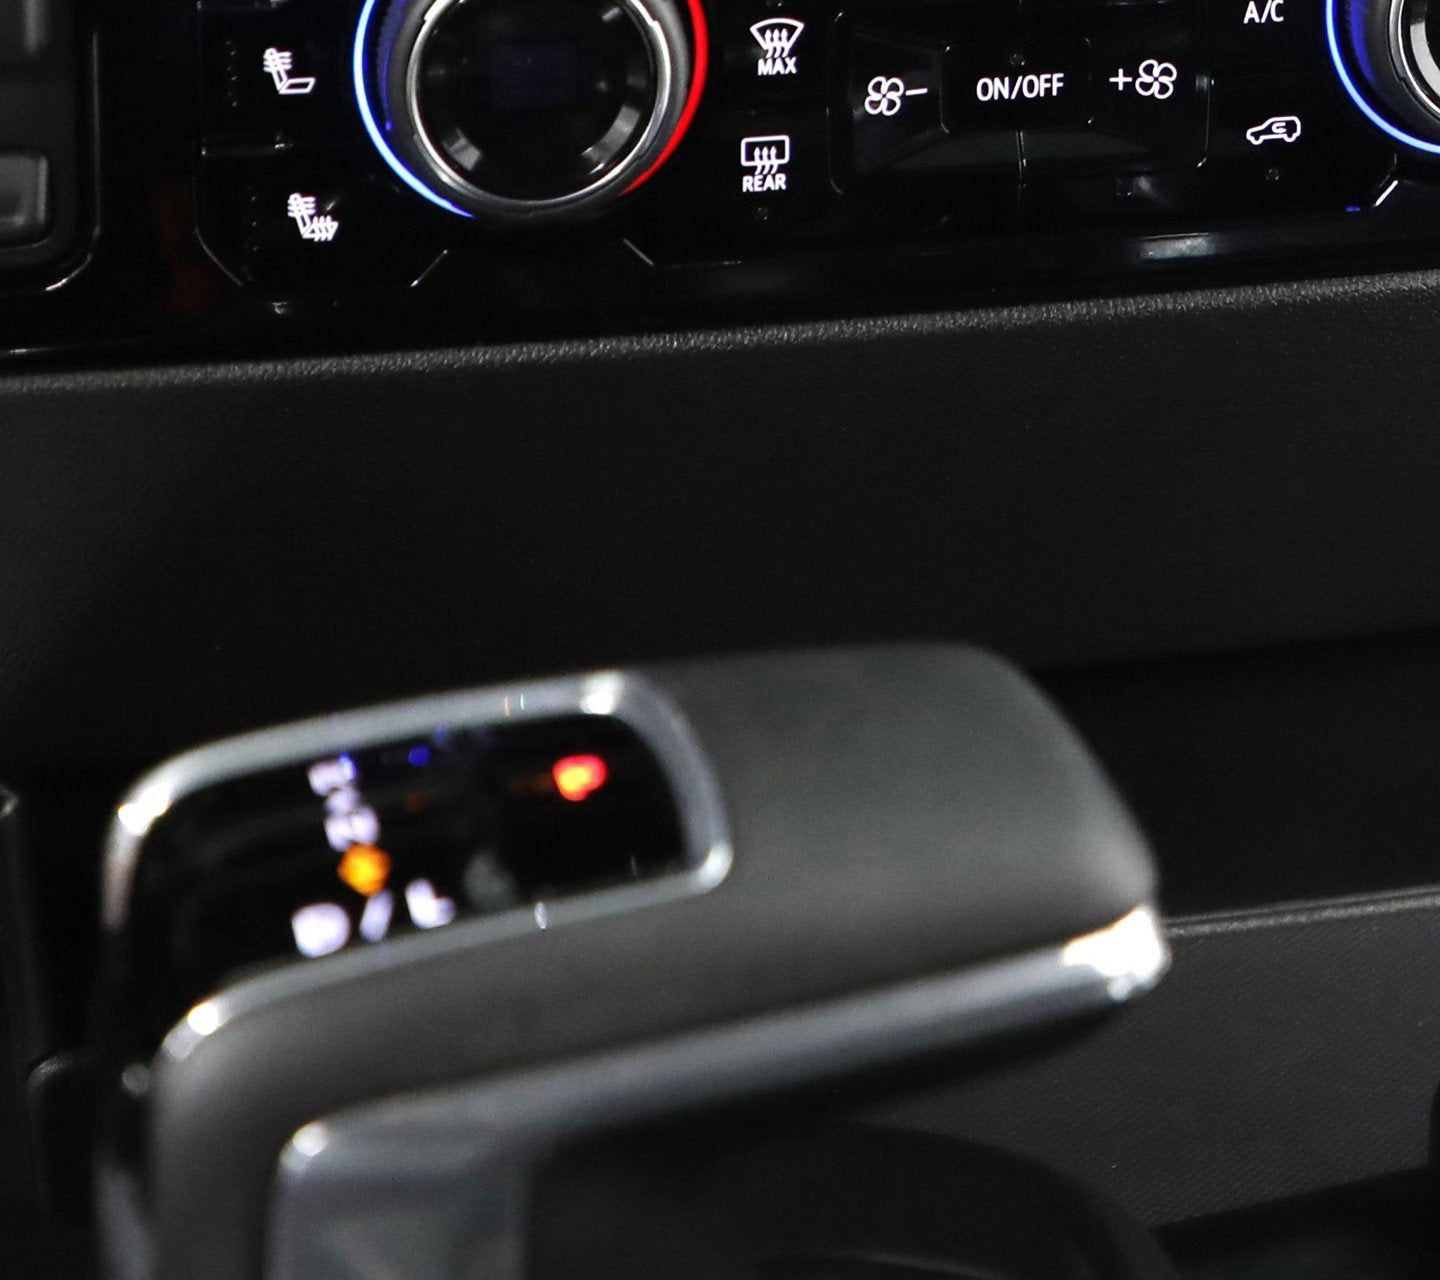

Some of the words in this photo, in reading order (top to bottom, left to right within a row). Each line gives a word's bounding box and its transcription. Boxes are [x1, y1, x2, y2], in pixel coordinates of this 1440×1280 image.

[757, 56, 797, 76] MAX
[976, 72, 1065, 102] ON/OFF
[742, 171, 787, 193] REAR
